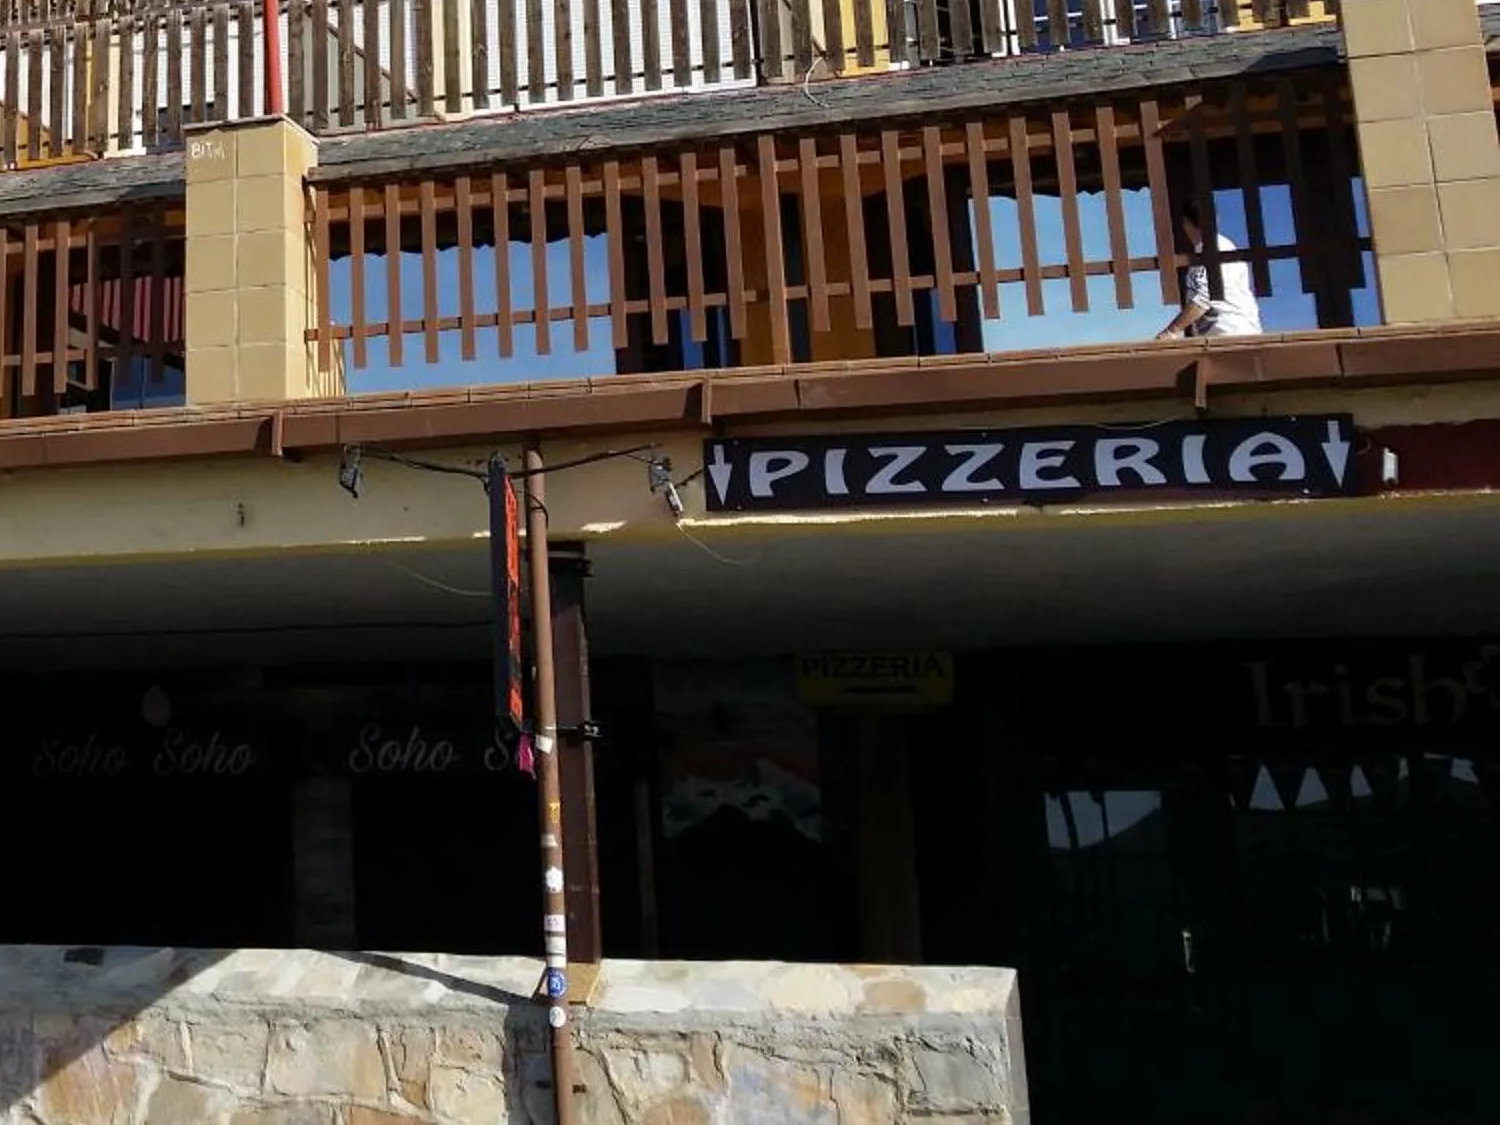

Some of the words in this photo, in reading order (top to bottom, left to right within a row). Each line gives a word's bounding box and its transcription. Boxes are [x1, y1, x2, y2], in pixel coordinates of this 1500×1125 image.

[749, 431, 1306, 497] PIZZERIA
[802, 651, 944, 678] PIZZERIA
[1233, 652, 1468, 731] Irish
[153, 726, 259, 779] Soho
[347, 722, 458, 774] Soho
